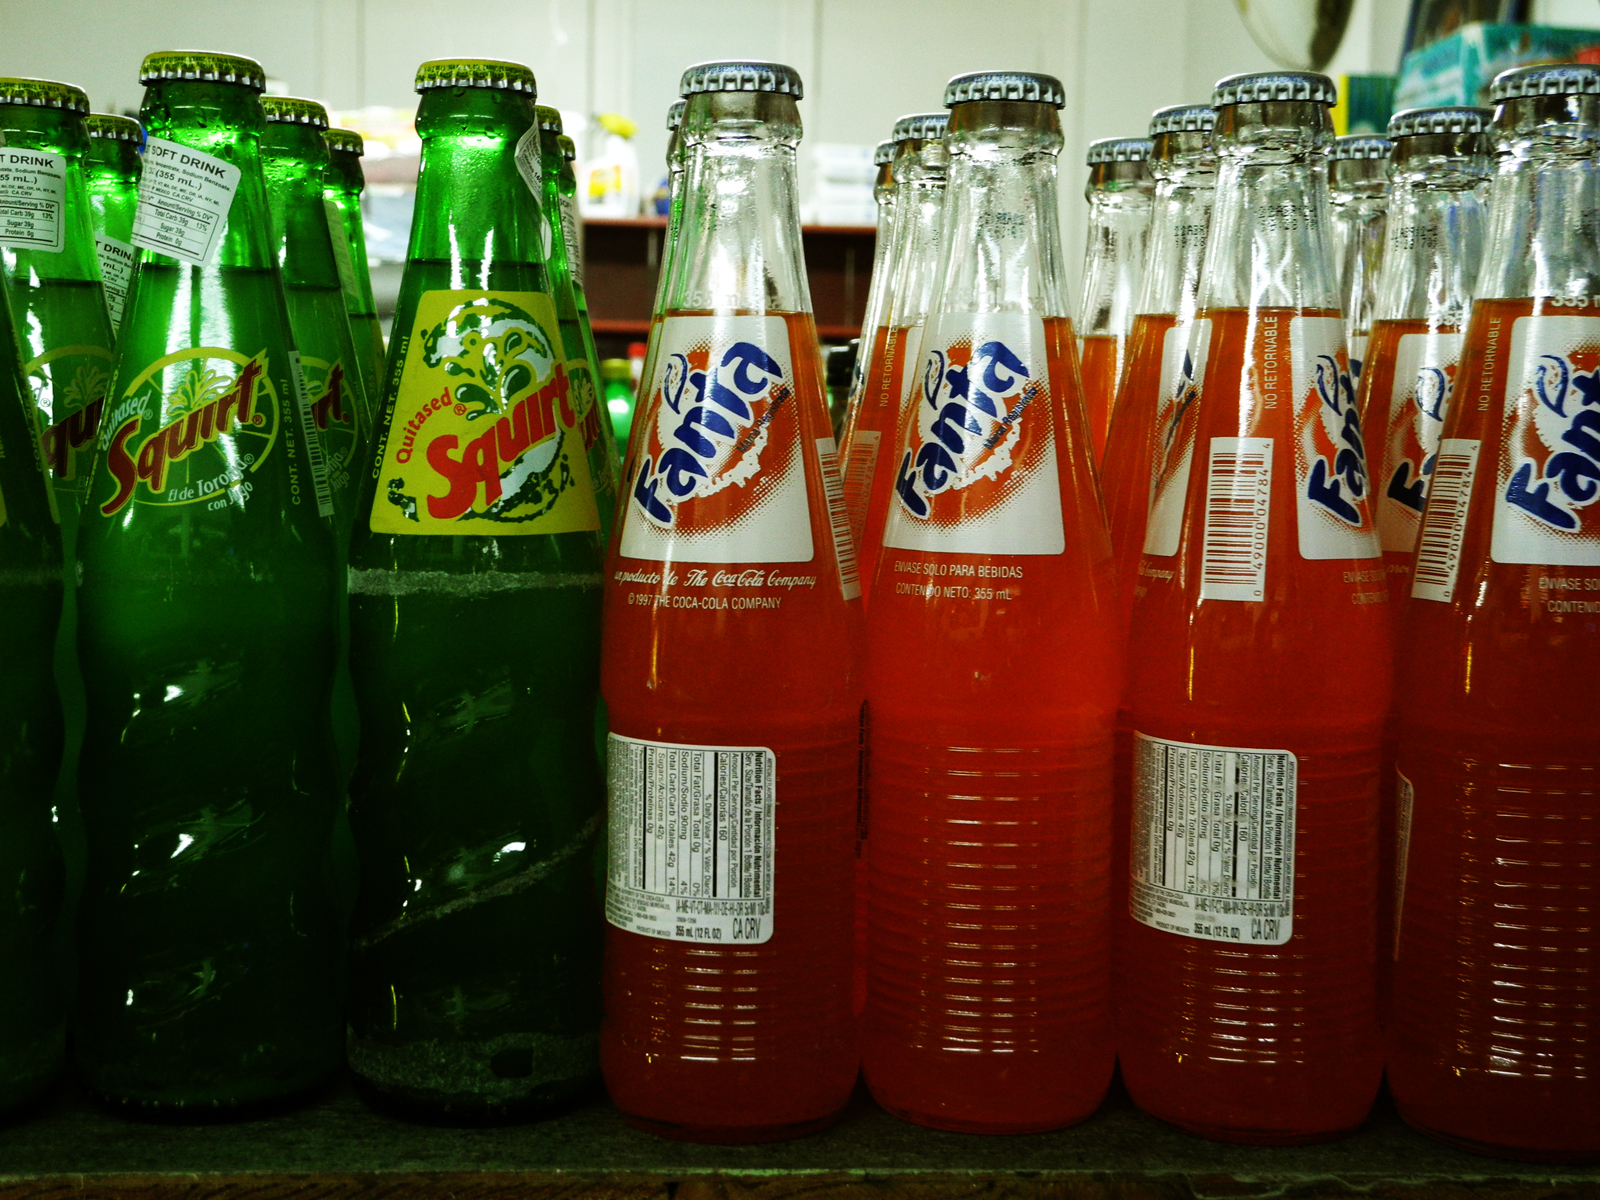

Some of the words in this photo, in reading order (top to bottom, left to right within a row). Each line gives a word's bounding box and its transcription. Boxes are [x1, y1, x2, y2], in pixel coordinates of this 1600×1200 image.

[10, 154, 54, 168] DRINK
[151, 145, 178, 160] SOFT
[179, 154, 226, 179] DRINK
[13, 176, 37, 184] mL.)
[155, 169, 175, 181] (355
[178, 177, 202, 191] mL.)
[182, 169, 203, 180] Sodium
[172, 190, 180, 198] CA
[181, 194, 194, 202] CRV
[157, 199, 195, 217] Amount/Serving
[155, 209, 165, 218] Total
[166, 212, 178, 222] Carb
[179, 217, 188, 227] 39g
[196, 222, 208, 232] 13%
[161, 222, 175, 232] Sugar
[175, 227, 185, 237] 39g
[156, 231, 173, 243] Protein
[104, 244, 133, 261] DRIN
[1551, 289, 1589, 307] 355
[882, 326, 898, 388] RETORNABLE
[1264, 315, 1278, 391] RETORNABLE
[1480, 317, 1502, 392] RETORNABLE
[879, 392, 888, 408] NO
[1264, 393, 1276, 410] NO
[1478, 395, 1489, 412] NO
[283, 400, 293, 424] 355
[372, 432, 389, 479] CONT.
[383, 389, 397, 426] NET.
[392, 359, 404, 383] 355
[101, 354, 267, 516] Squirt
[396, 386, 453, 464] Quitased
[634, 342, 783, 524] Fanta
[896, 341, 1030, 517] Fanta
[283, 433, 296, 460] NET.
[426, 362, 576, 520] Squirt
[736, 429, 760, 453] Marca
[168, 489, 178, 502] El
[179, 489, 194, 501] de
[289, 463, 301, 506] CONT.
[207, 499, 227, 511] con
[227, 482, 254, 506] Jugo
[620, 568, 660, 586] producto
[683, 569, 709, 587] The
[712, 570, 765, 587] Coca-Cola
[767, 570, 817, 590] Company
[894, 561, 922, 574] ENVASE
[923, 563, 947, 576] SOLO
[949, 564, 975, 576] PARA
[978, 566, 1023, 578] BEBIDAS
[896, 583, 941, 598] CONTENIDO
[943, 586, 972, 599] NETO:
[974, 587, 993, 599] 355
[996, 589, 1012, 600] mL
[1538, 577, 1581, 590] ENVASE
[1584, 578, 1600, 590] SO
[654, 594, 670, 608] THE
[672, 596, 728, 609] COCA-COLA
[731, 597, 781, 609] COMPANY
[1548, 601, 1600, 613] CONTENID
[669, 751, 677, 770] Total
[745, 752, 753, 768] Serv.
[755, 752, 763, 783] Nutrition
[1190, 751, 1198, 770] Total
[1253, 755, 1261, 780] Amount
[1267, 755, 1275, 770] Serv.
[1277, 755, 1285, 786] Nutrition
[657, 753, 665, 821] Sugars/Azúcares
[681, 751, 689, 813] Sodium/Sodio
[719, 752, 728, 822] Calories/Calorías
[745, 770, 753, 807] Size/Tamaño
[1168, 748, 1176, 818] Protein/Proteínas
[1178, 753, 1186, 820] Sugars/Azúcares
[1201, 752, 1210, 812] Sodium/Sodio
[1266, 772, 1275, 809] Size/Tamaño
[669, 773, 677, 816] Carb/Carb
[693, 775, 701, 816] Fat/Grasa
[754, 785, 763, 804] Facts
[1189, 773, 1197, 815] Carb/Carb
[1276, 788, 1285, 807] Facts
[703, 802, 712, 820] Daily
[730, 793, 739, 848] Serving/Cantidad
[745, 808, 753, 816] de
[1250, 795, 1259, 849] Serving/Cantidad
[647, 823, 654, 833] 0g
[655, 824, 664, 840] 42g
[679, 815, 688, 840] 90mg
[693, 820, 701, 839] Total
[719, 826, 727, 841] 160
[754, 811, 762, 853] Información
[1167, 821, 1174, 831] 0g
[1176, 823, 1185, 838] 42g
[1188, 818, 1197, 847] Totales
[1275, 814, 1284, 856] Información
[692, 842, 701, 852] 0g
[1212, 841, 1220, 852] 0g
[1265, 827, 1273, 849] Porción
[667, 851, 675, 868] 42g
[1187, 850, 1195, 866] 42g
[754, 856, 762, 897] Nutrimental
[1250, 864, 1258, 889] Porción
[1274, 858, 1282, 899] Nutrimental
[680, 881, 687, 895] 4%
[693, 883, 701, 896] 0%
[694, 929, 703, 940] (12
[704, 929, 711, 939] FL
[732, 918, 743, 939] CA
[744, 918, 761, 939] CRV
[1251, 919, 1262, 940] CA
[1263, 918, 1280, 940] CRV
